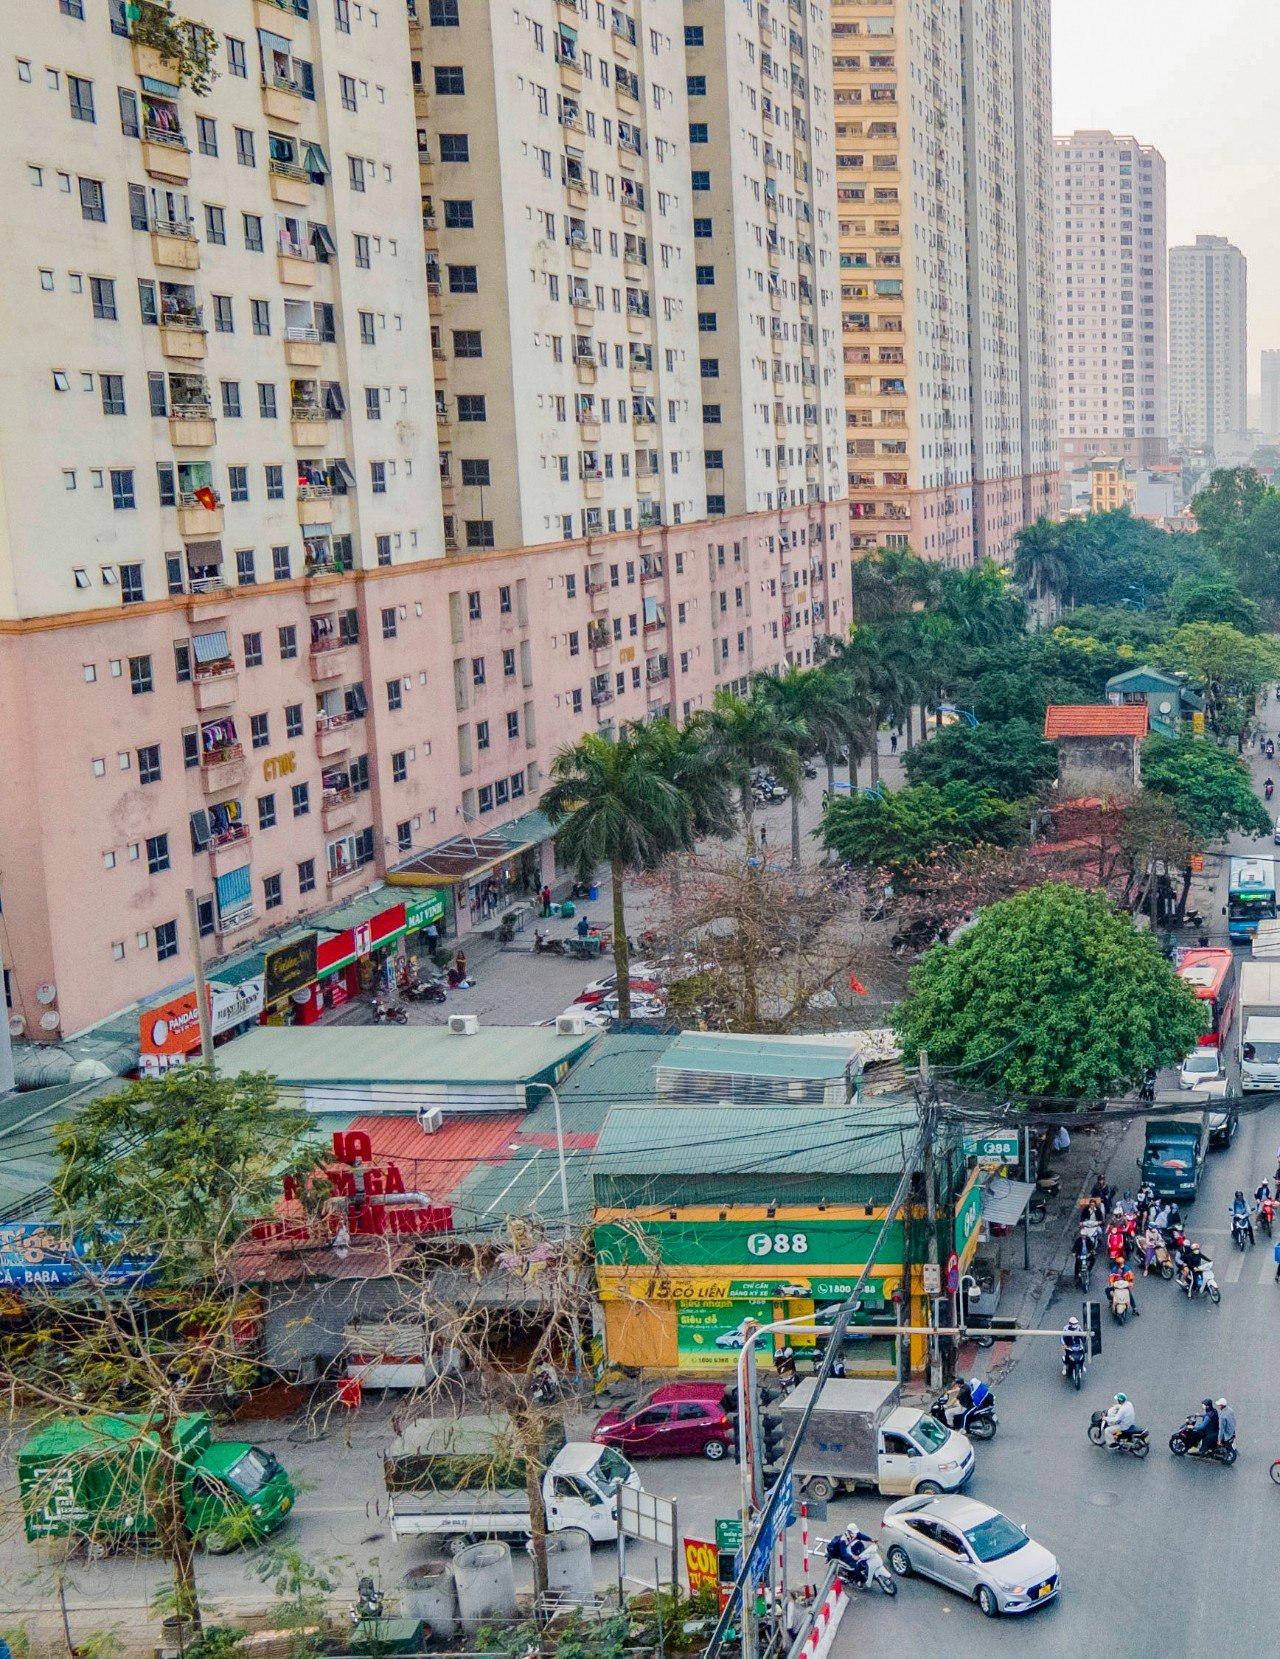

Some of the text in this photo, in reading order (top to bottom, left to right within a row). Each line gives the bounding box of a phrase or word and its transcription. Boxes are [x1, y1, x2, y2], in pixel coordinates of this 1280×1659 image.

[983, 1142, 1011, 1154] F88
[747, 1233, 808, 1256] F88
[24, 1270, 60, 1283] BABA
[829, 1285, 851, 1293] 1800
[681, 1315, 702, 1324] Siêu
